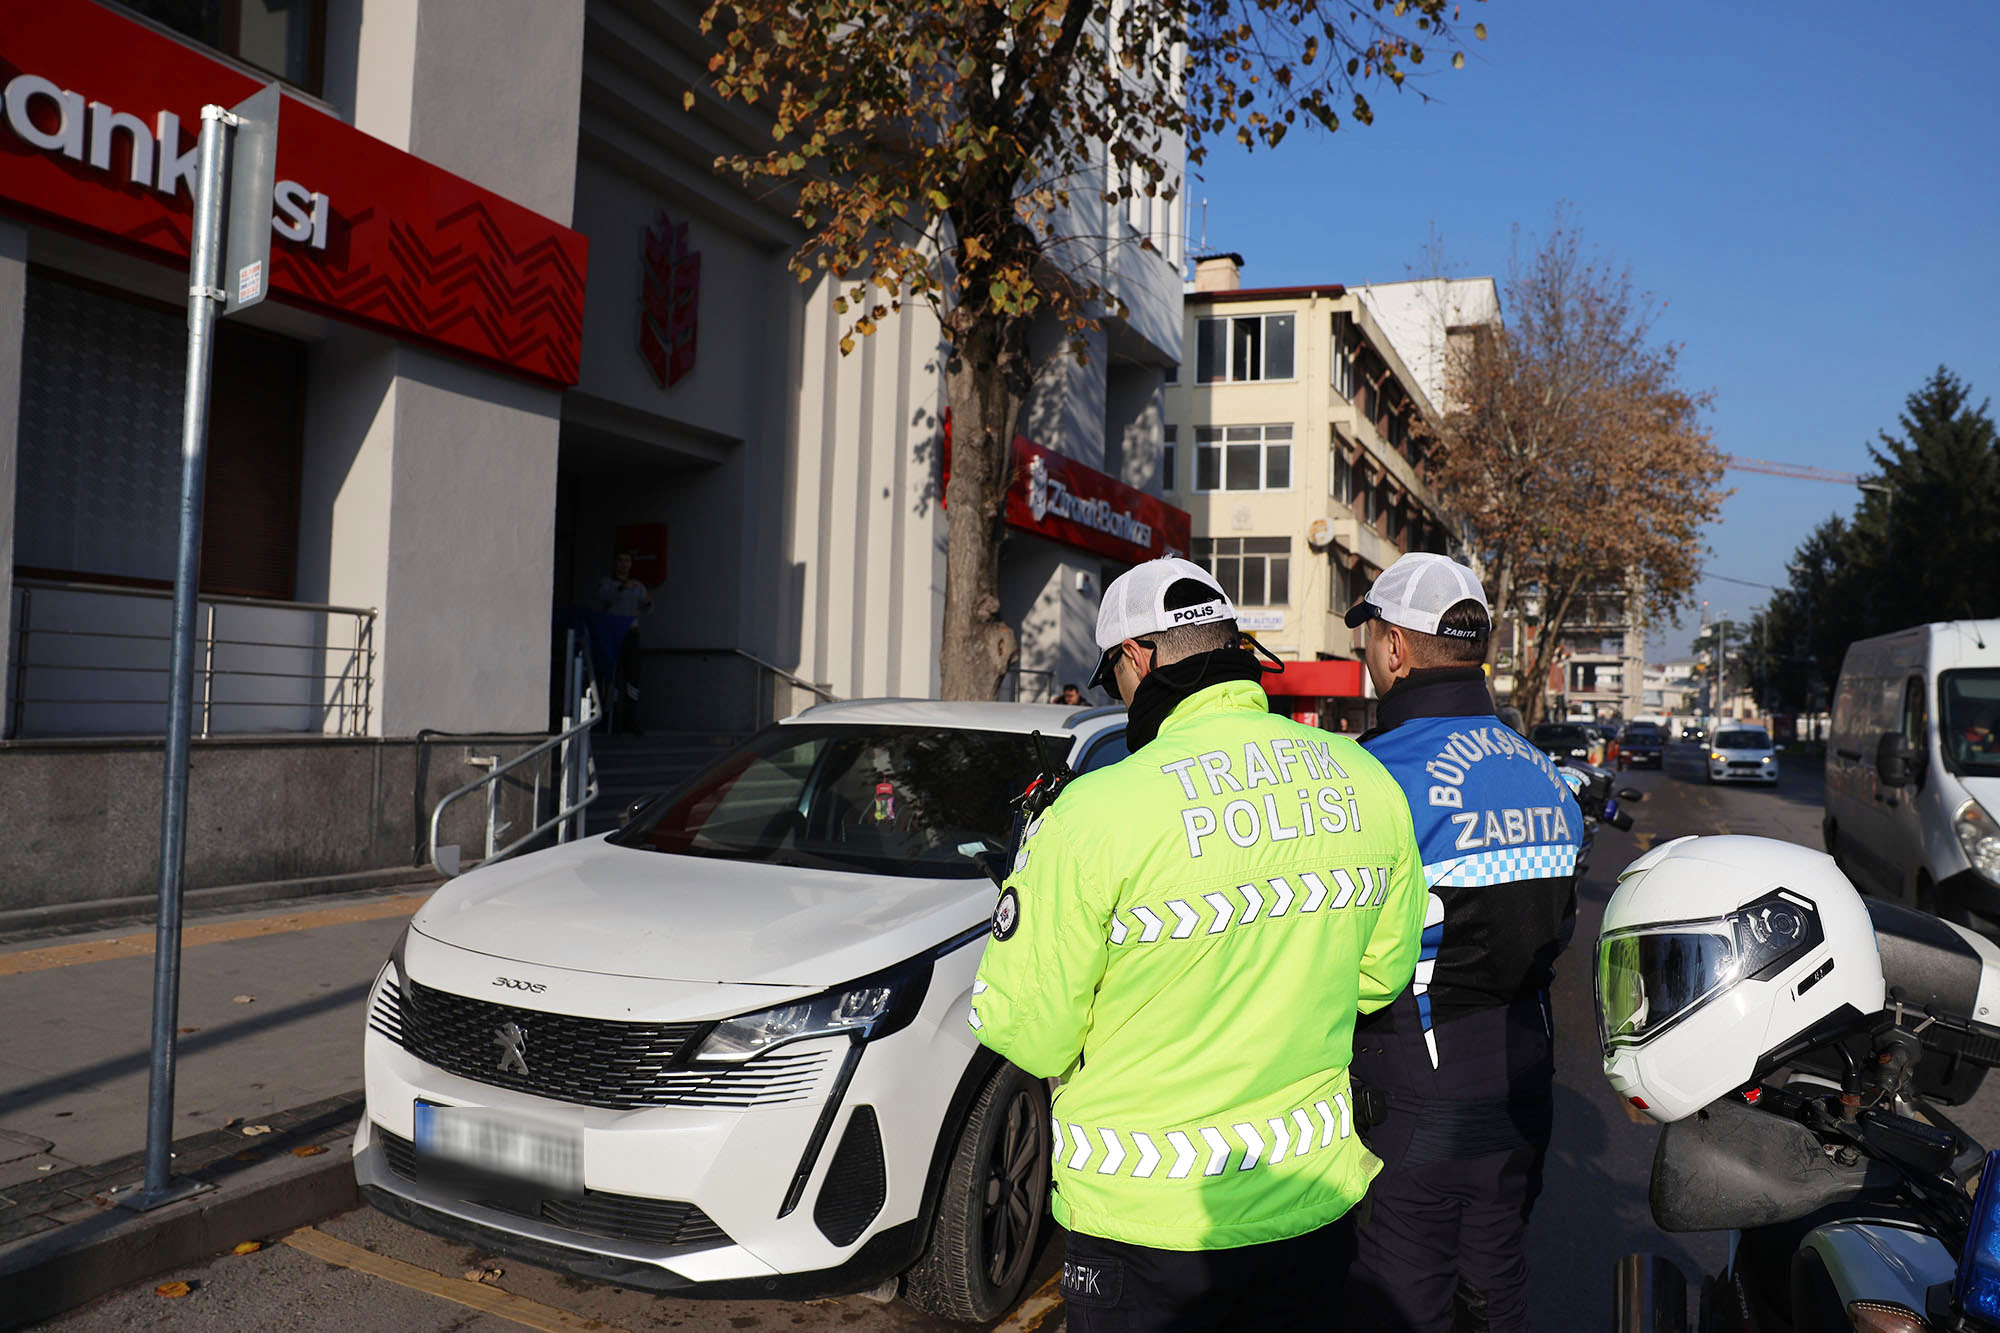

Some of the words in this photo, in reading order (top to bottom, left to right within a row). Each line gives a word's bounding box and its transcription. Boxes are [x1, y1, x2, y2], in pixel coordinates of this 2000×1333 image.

[1443, 627, 1476, 638] ZABITA
[1451, 806, 1572, 851] ZABITA
[492, 976, 547, 994] 3008
